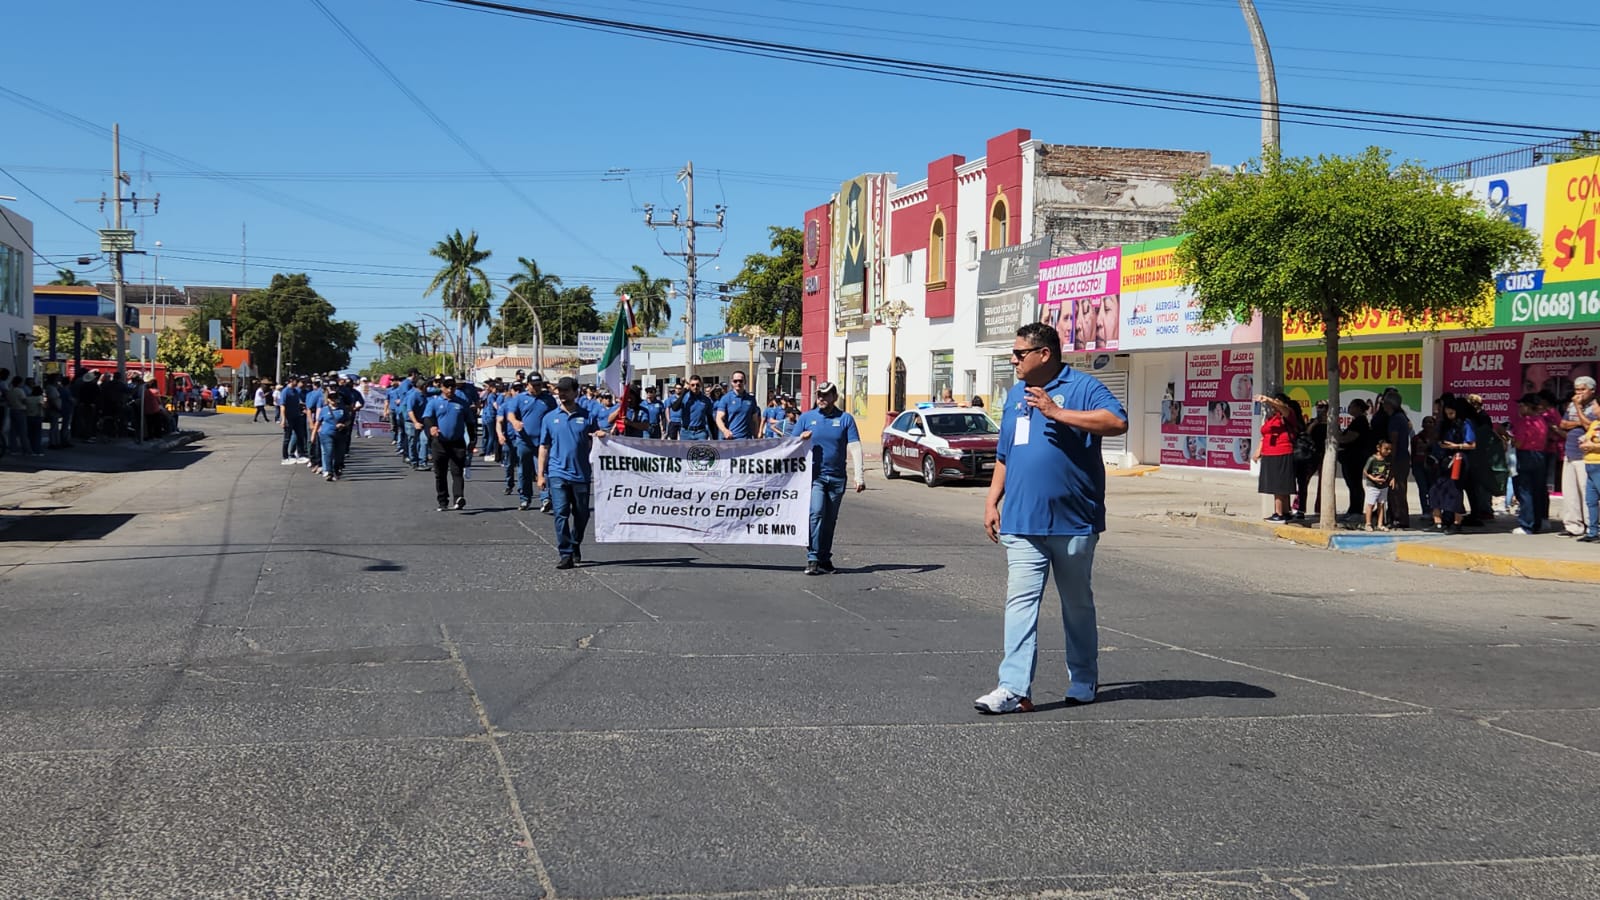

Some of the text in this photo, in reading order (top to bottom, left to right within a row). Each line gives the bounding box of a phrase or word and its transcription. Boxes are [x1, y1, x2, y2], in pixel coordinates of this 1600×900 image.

[1039, 260, 1093, 281] TRATAMIENTOS
[1093, 255, 1118, 273] LÁSER
[1123, 270, 1167, 286] ENFERMEDADES
[1168, 268, 1177, 280] DE
[1505, 274, 1535, 291] CITAS
[1057, 282, 1076, 295] BAJO
[1076, 278, 1102, 294] COSTO!
[1155, 300, 1181, 311] ALERGIAS
[1533, 291, 1576, 322] (668)
[1156, 313, 1179, 323] VITILIGO
[1132, 326, 1147, 337] PAÑO
[1156, 325, 1179, 335] HONGOS
[763, 338, 801, 351] FAMA
[1449, 339, 1517, 353] TRATAMIENTOS
[1529, 335, 1590, 350] ¡Resultados
[1232, 352, 1248, 361] LÁSER
[1524, 346, 1597, 360] comprobados!
[1285, 353, 1423, 380] SANAOS TU PIEL
[1461, 352, 1505, 372] LÁSER
[1197, 367, 1212, 377] LÁSER
[1453, 380, 1485, 388] CICATRICES
[1485, 379, 1494, 387] DE
[599, 455, 807, 474] TELEFONISTAS PRESENTES
[607, 484, 799, 503] ¡En Unidad y en Defensa
[627, 502, 780, 520] de nuestro Empleo!
[758, 524, 768, 535] DE
[771, 524, 796, 535] MAYO
